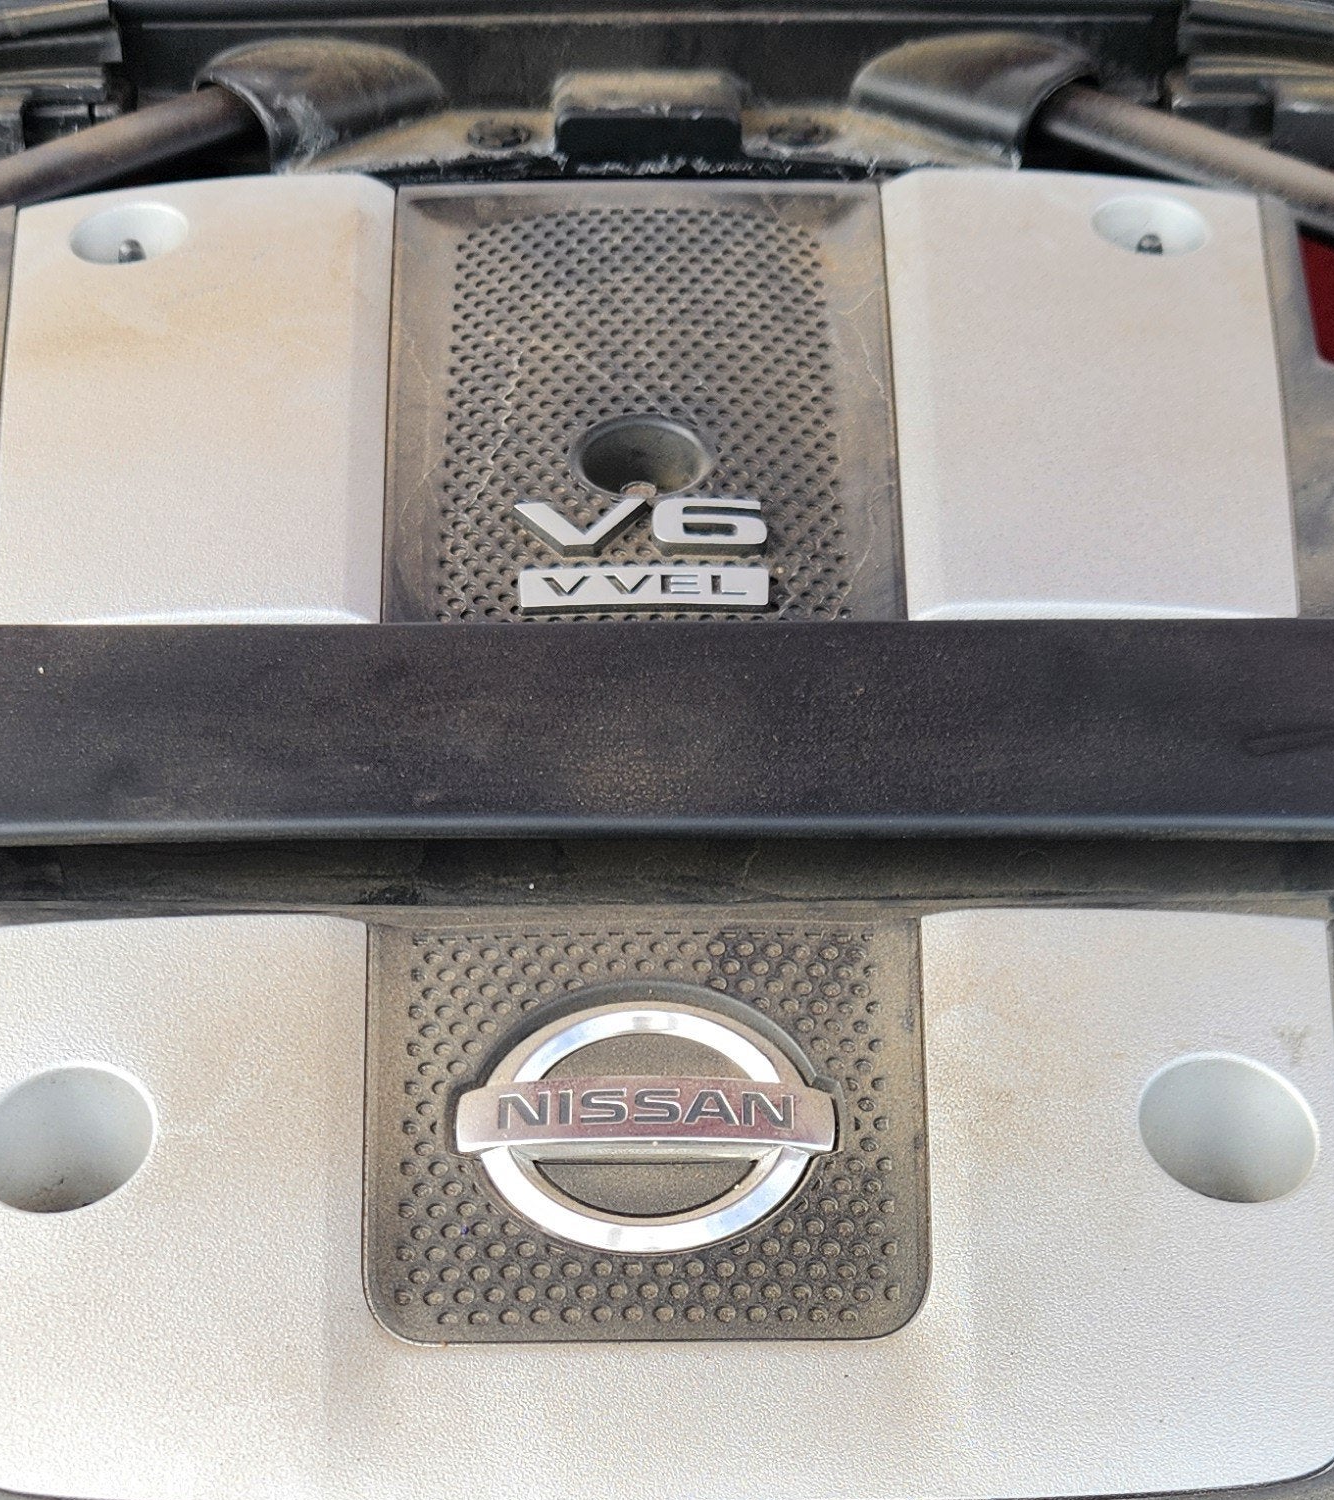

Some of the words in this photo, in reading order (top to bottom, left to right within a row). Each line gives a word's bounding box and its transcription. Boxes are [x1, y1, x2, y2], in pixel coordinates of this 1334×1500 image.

[513, 498, 768, 552] V6
[541, 573, 748, 598] VVEL
[497, 1087, 796, 1131] NISSAN
